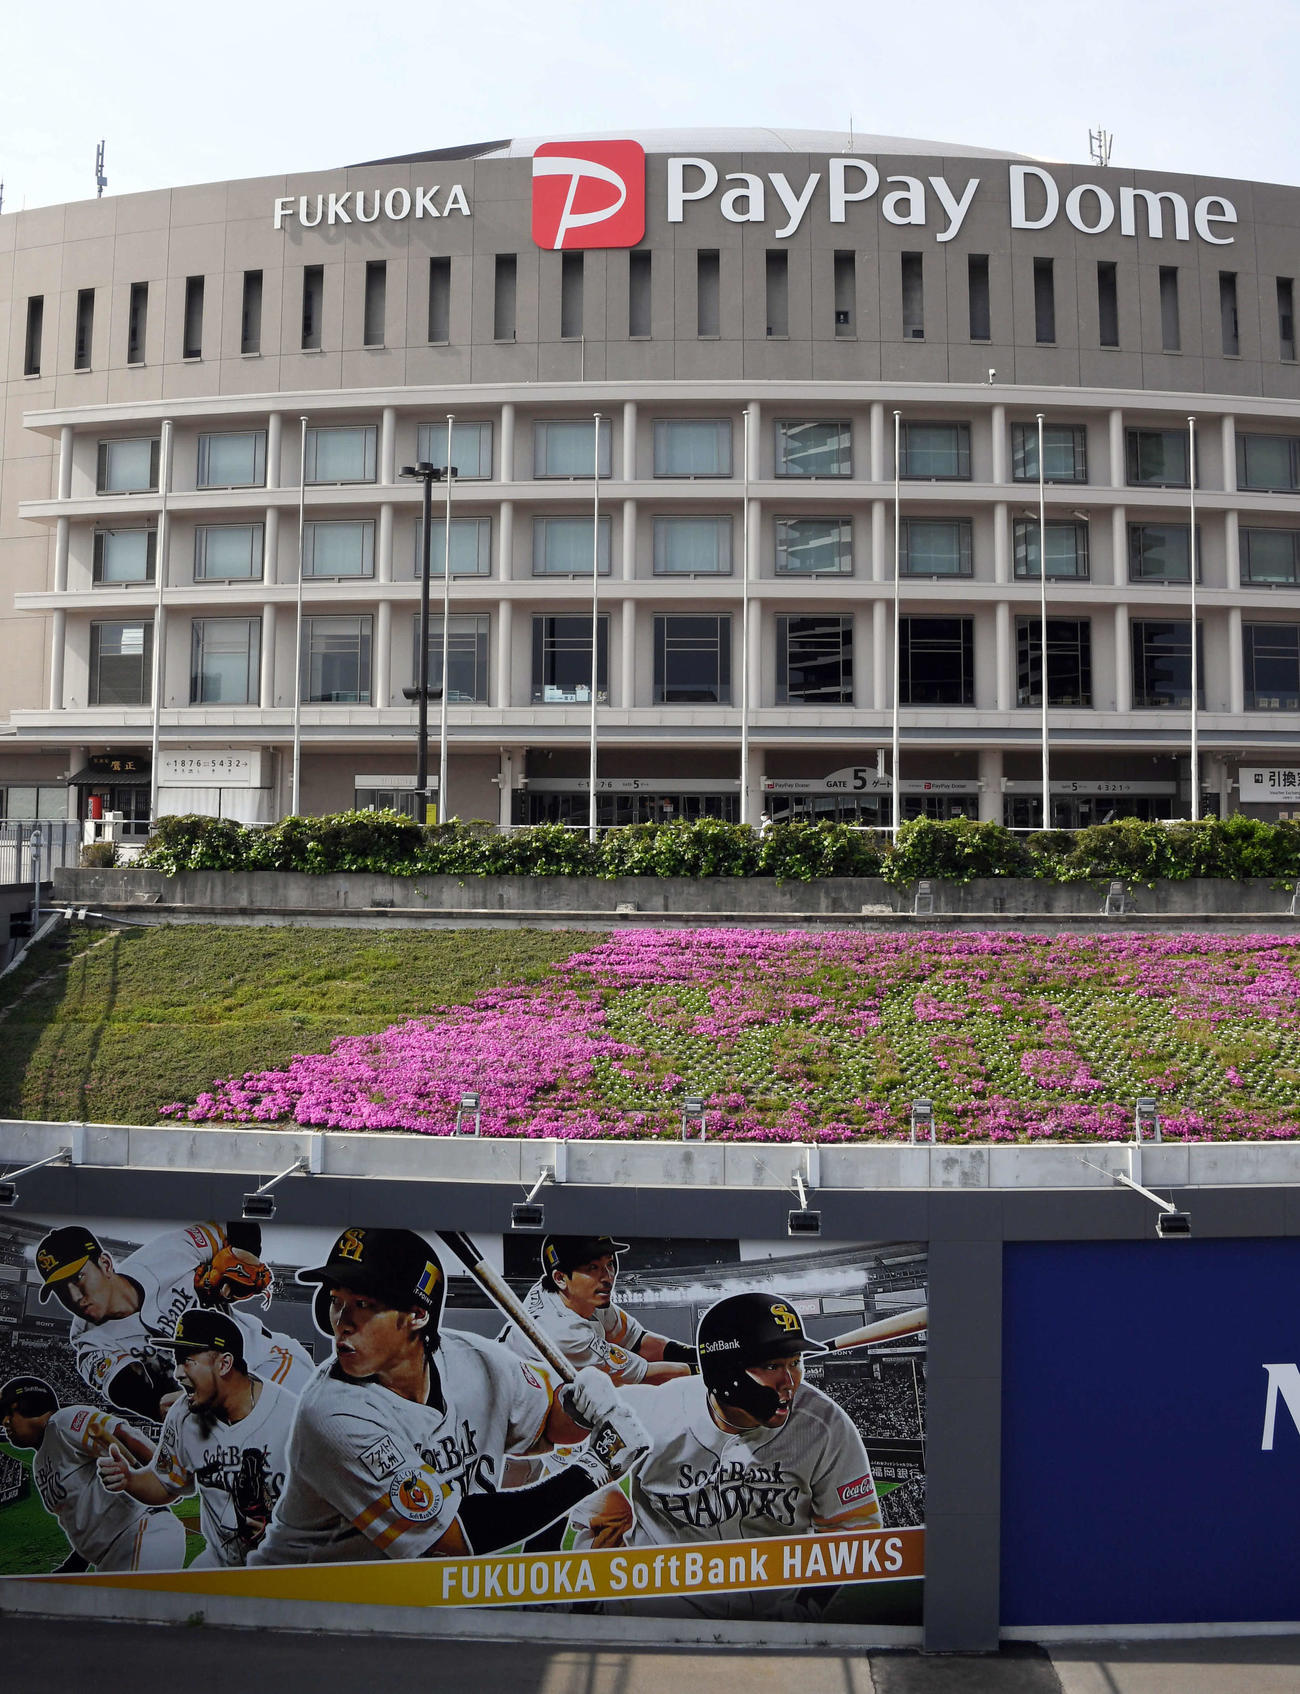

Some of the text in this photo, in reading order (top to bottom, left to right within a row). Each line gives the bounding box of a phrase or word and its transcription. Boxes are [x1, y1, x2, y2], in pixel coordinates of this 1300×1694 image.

[273, 183, 472, 231] FUKUOKA
[667, 157, 980, 242] PayPay
[1009, 164, 1239, 246] Dome
[826, 780, 847, 788] GATE
[853, 768, 867, 790] 5
[130, 1287, 193, 1362] SotBank
[705, 1338, 741, 1353] SoftBank
[391, 1469, 422, 1497] FUKUOA
[679, 1461, 785, 1489] SoftBank
[871, 1466, 922, 1480] 福岡銀行
[652, 1485, 800, 1528] HAWKS
[441, 1536, 905, 1600] FUKUOKA SoftBank HAWKS
